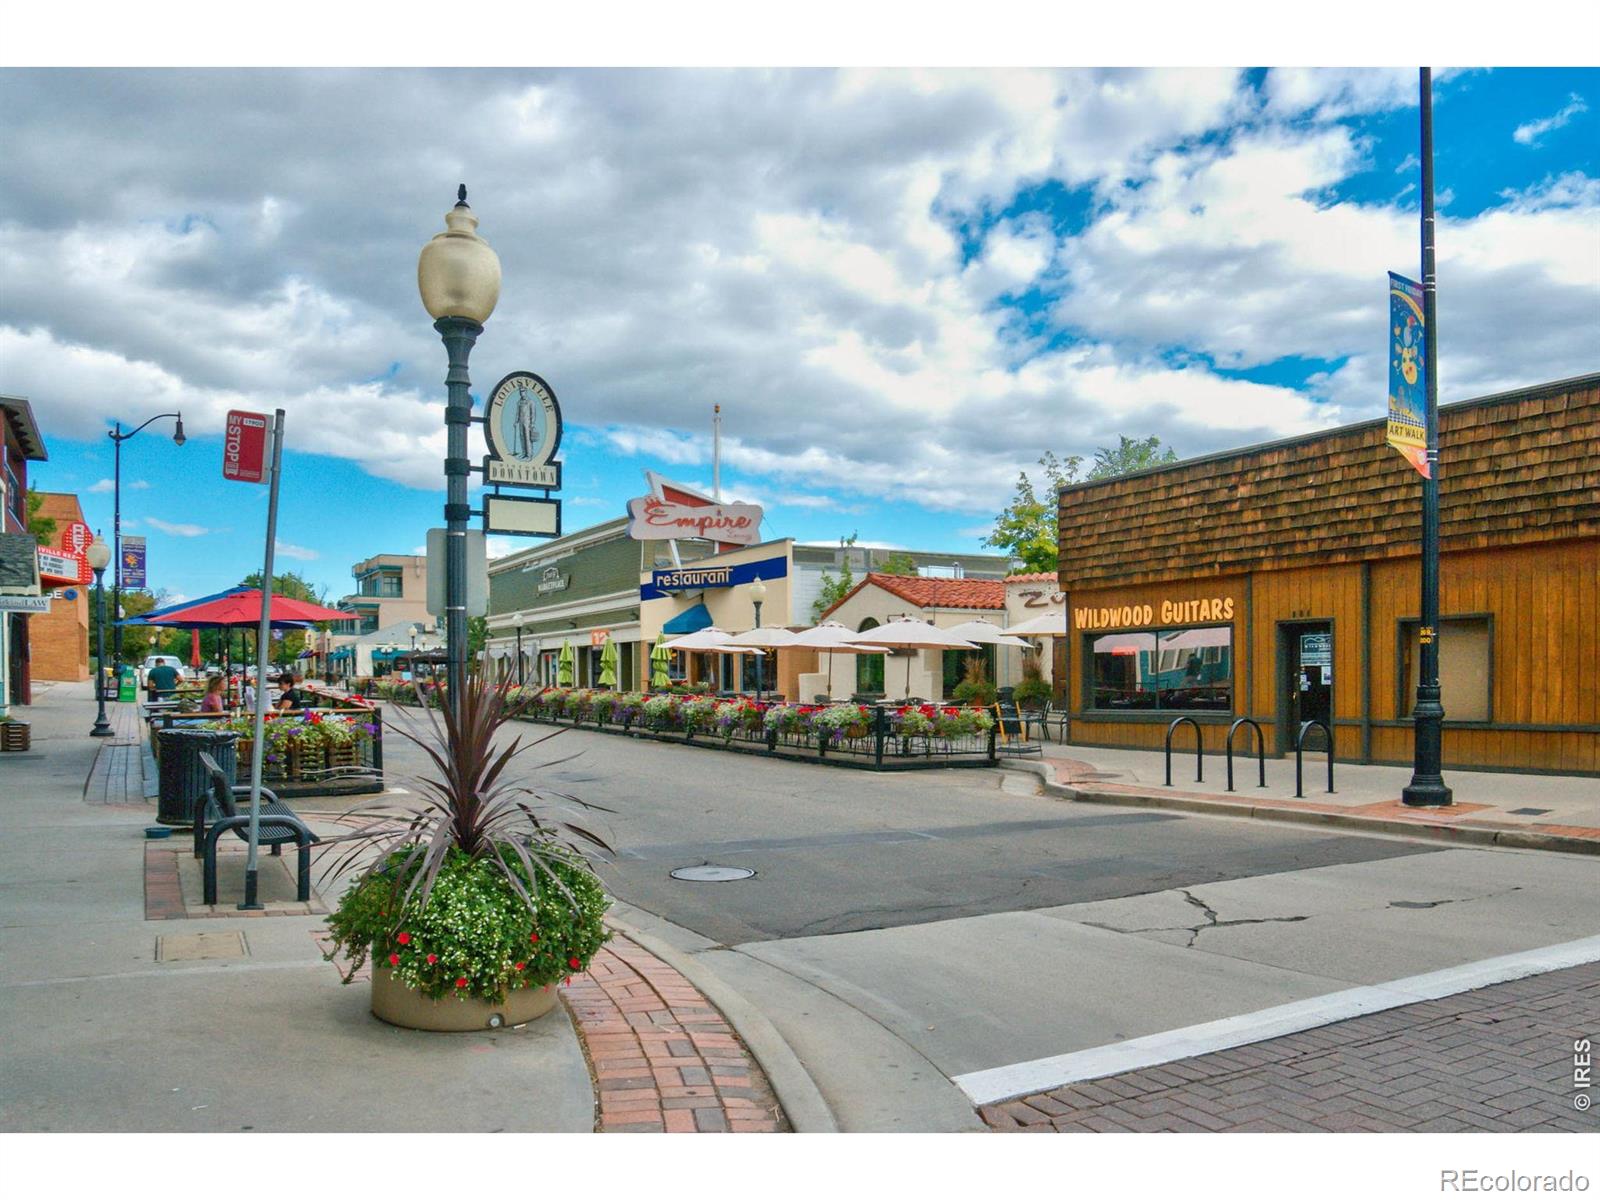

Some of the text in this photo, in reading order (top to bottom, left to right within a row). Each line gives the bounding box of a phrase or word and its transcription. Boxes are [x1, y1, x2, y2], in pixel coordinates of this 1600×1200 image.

[494, 378, 554, 413] LOUISVILLE
[227, 425, 241, 462] STOP
[1389, 423, 1424, 440] ART WALK
[644, 497, 752, 537] Empire
[72, 523, 84, 555] REX
[656, 566, 734, 587] restaurant
[1075, 597, 1235, 630] WILDWOOD GUITARS
